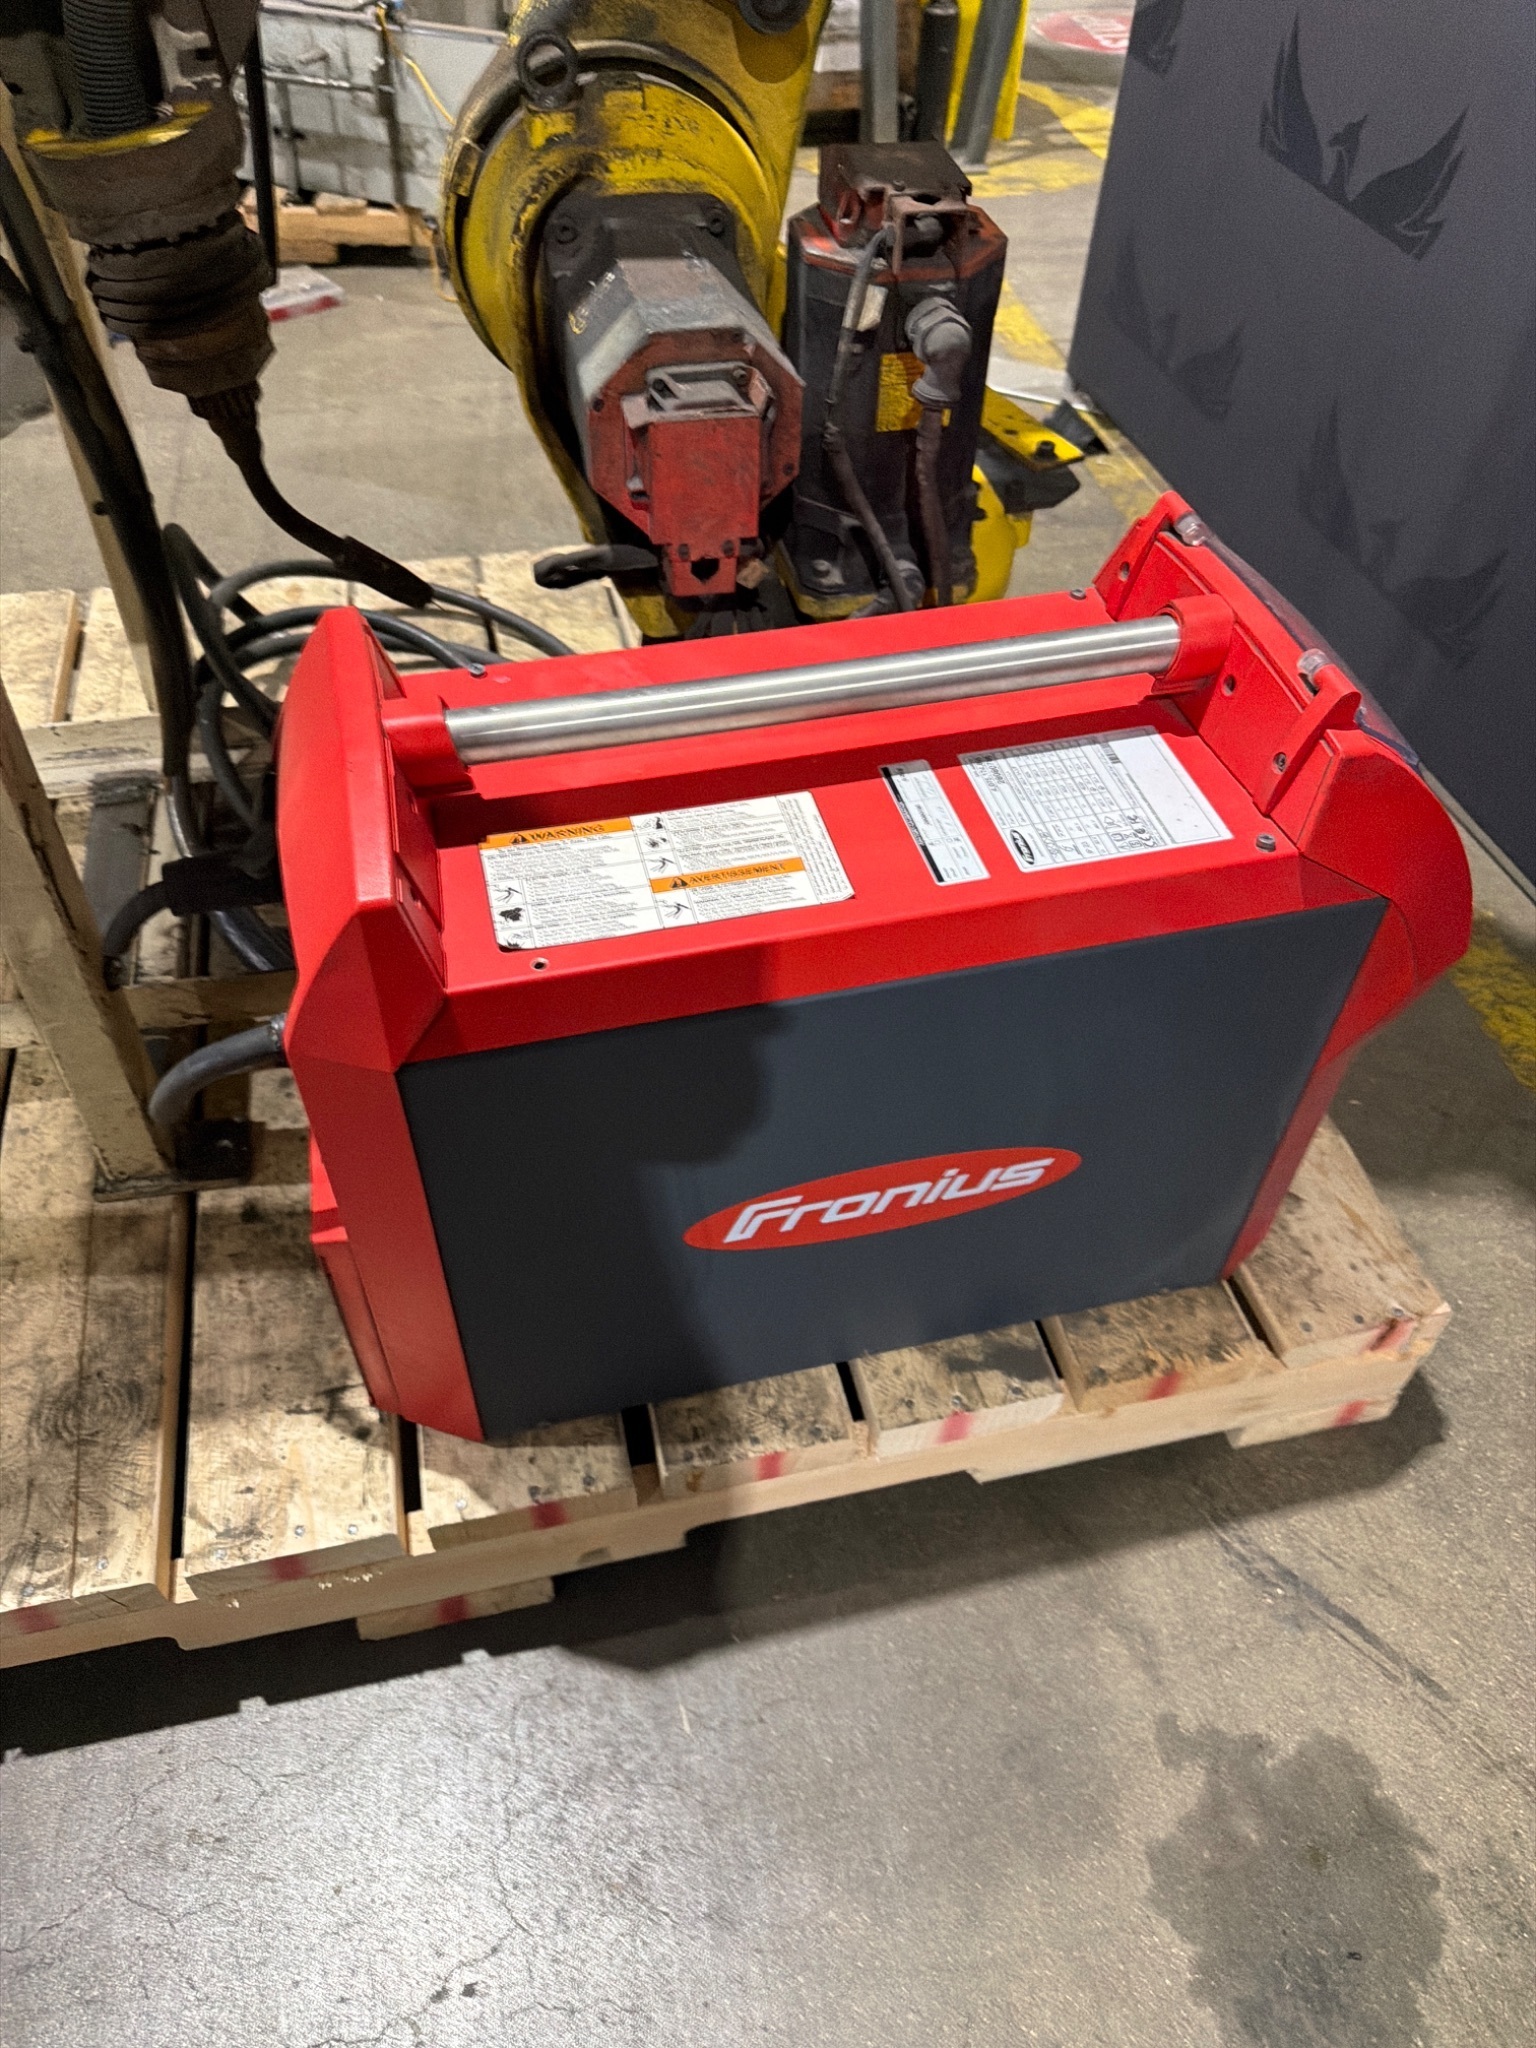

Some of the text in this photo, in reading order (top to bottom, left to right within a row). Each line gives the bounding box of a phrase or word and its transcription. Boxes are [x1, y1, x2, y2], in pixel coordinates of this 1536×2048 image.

[528, 824, 606, 841] WARNING
[689, 863, 786, 884] AVERTISSEMENT
[723, 1158, 1055, 1243] Fronius
